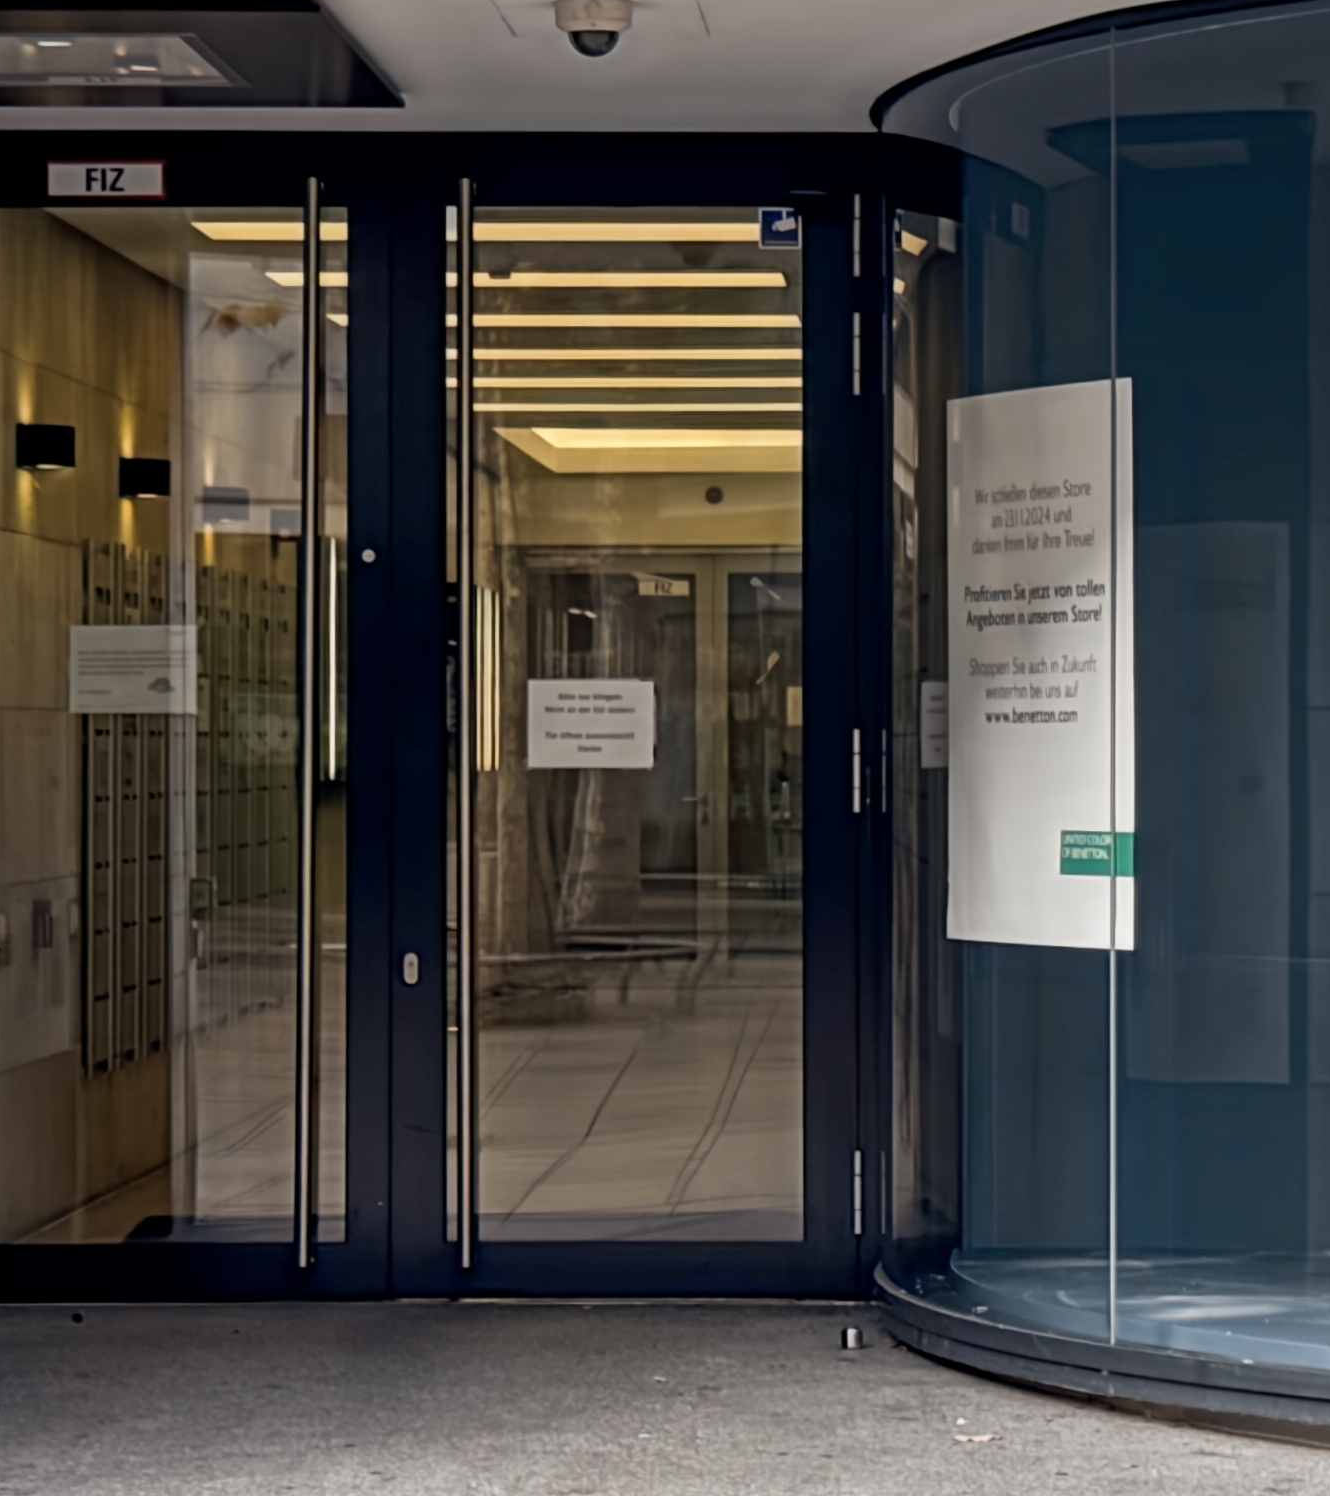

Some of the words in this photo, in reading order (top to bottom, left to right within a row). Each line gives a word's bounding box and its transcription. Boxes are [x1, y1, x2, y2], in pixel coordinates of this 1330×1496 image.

[86, 168, 125, 192] FIZ
[1063, 479, 1092, 498] Store
[1064, 527, 1096, 548] Treue!
[1054, 585, 1073, 599] von
[1076, 579, 1106, 597] tollen
